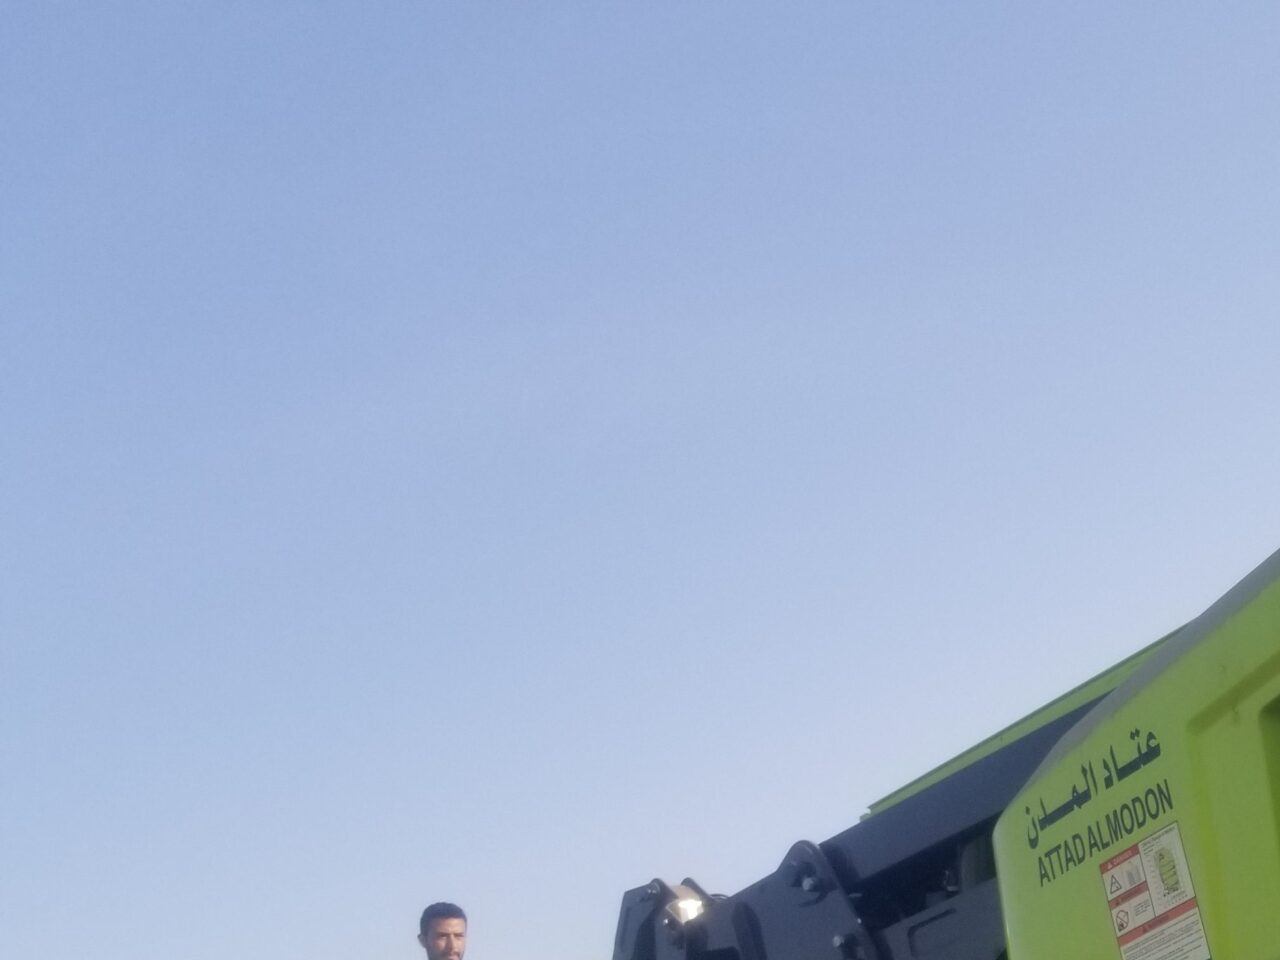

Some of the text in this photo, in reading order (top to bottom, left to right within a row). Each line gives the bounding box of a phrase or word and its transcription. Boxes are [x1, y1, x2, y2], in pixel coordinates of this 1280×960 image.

[1102, 728, 1161, 789] عتاد
[1025, 760, 1098, 849] المدن
[1038, 833, 1086, 887] ATTAD
[1088, 779, 1173, 857] ALMODON
